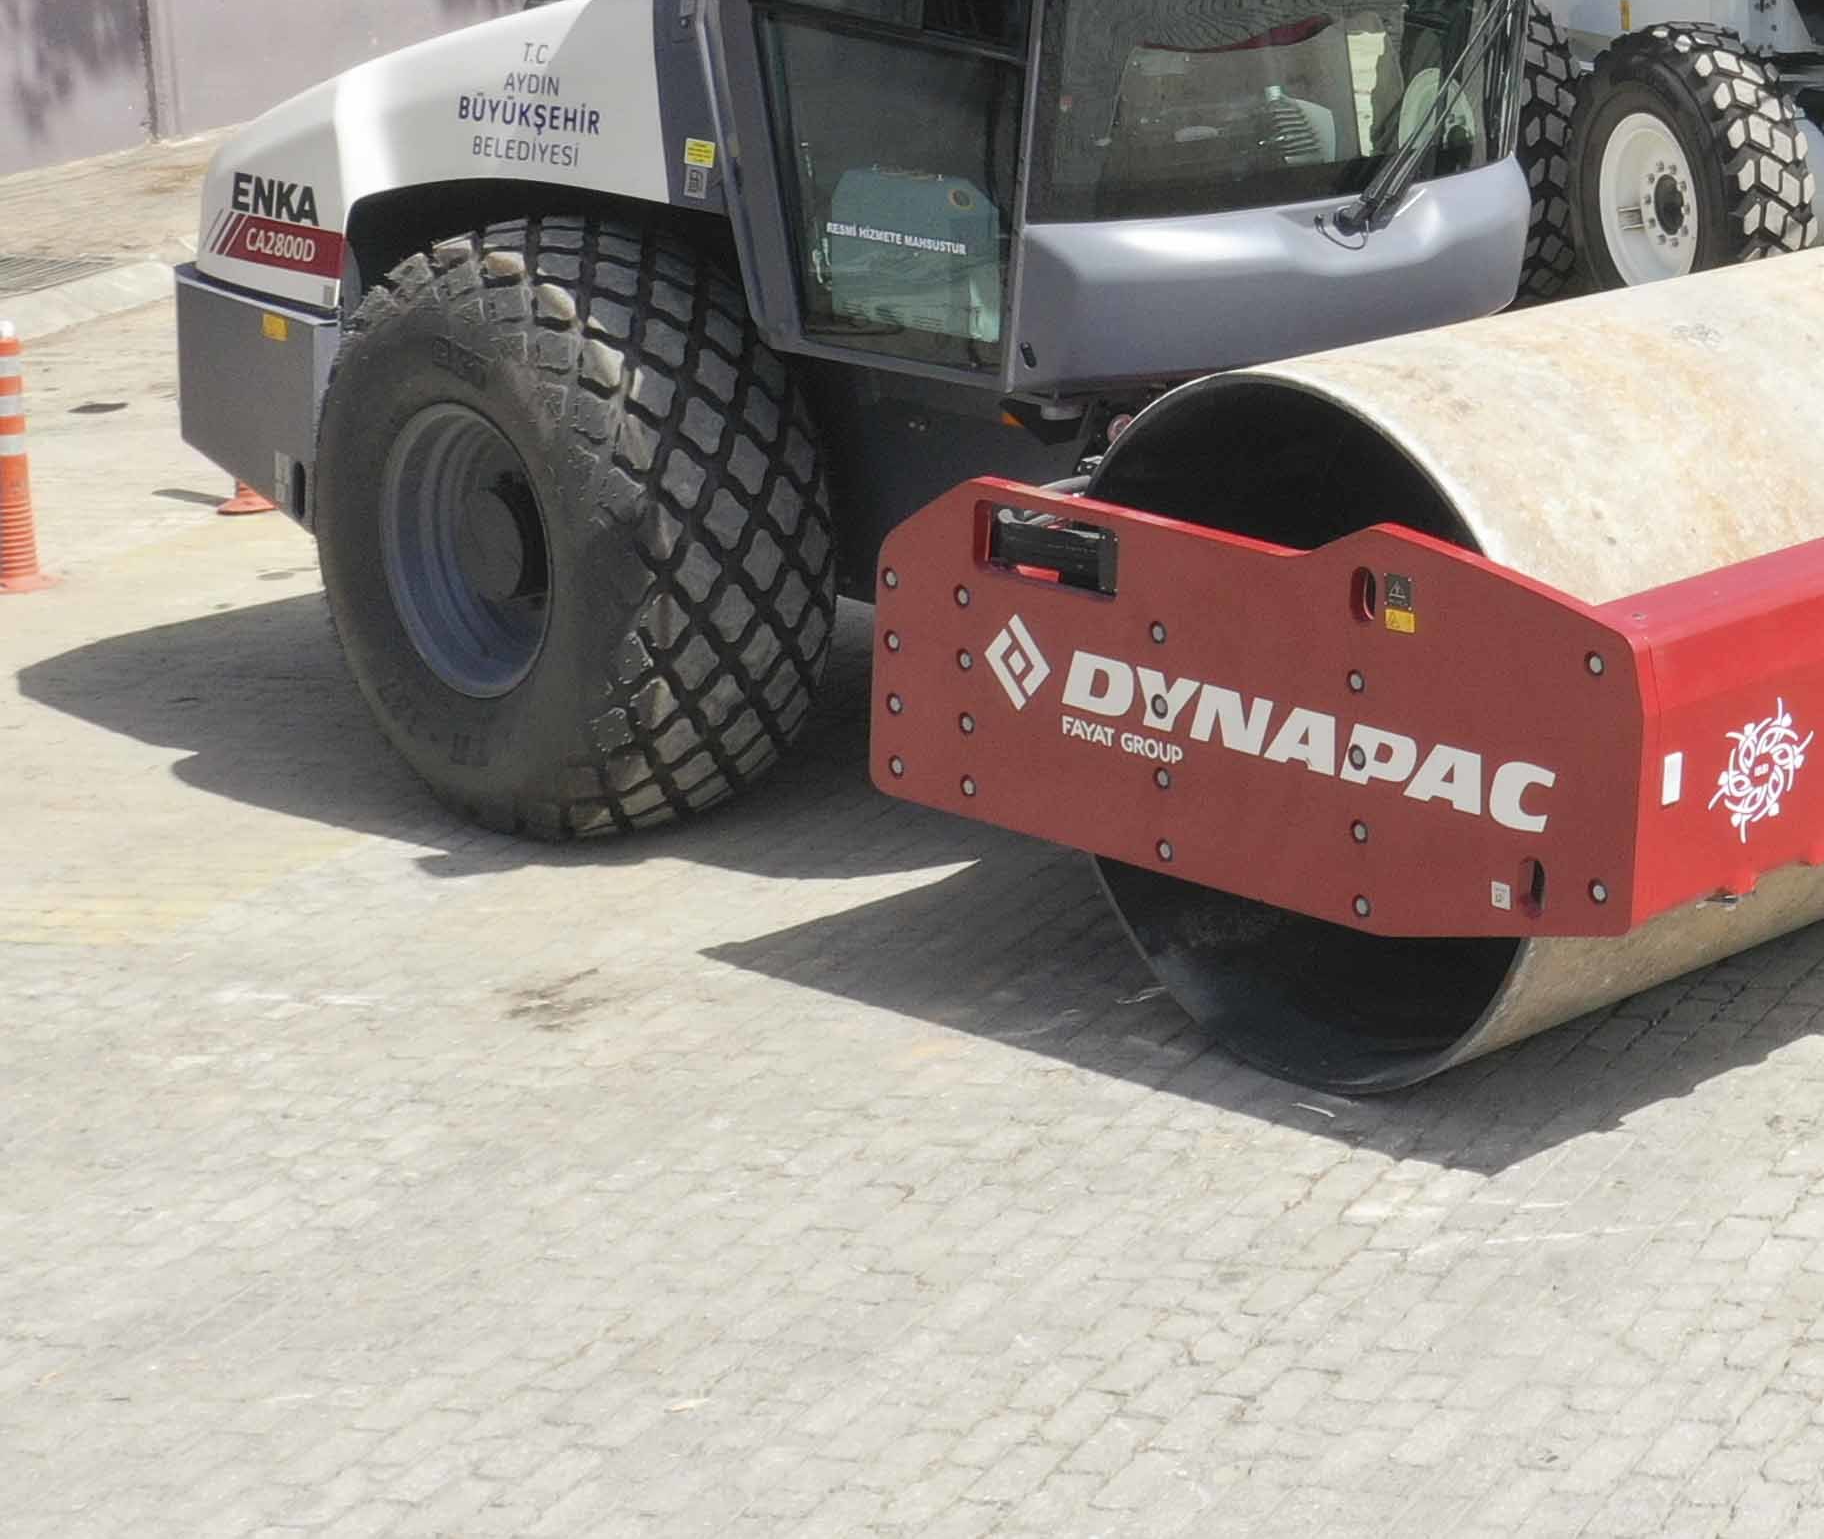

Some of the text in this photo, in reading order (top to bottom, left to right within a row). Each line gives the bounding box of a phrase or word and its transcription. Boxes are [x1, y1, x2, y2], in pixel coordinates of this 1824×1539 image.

[504, 72, 560, 96] AYDIN
[458, 93, 601, 135] BÜYÜKŞEHİR
[472, 135, 580, 167] BELEDİYESİ
[231, 171, 320, 227] ENKA
[245, 227, 316, 262] CA2800D
[826, 221, 968, 256] RESMİ HİZMETE MAHSUSTUR
[1061, 715, 1184, 764] FAYAT GROUP
[1061, 650, 1556, 832] DYNAPAC
